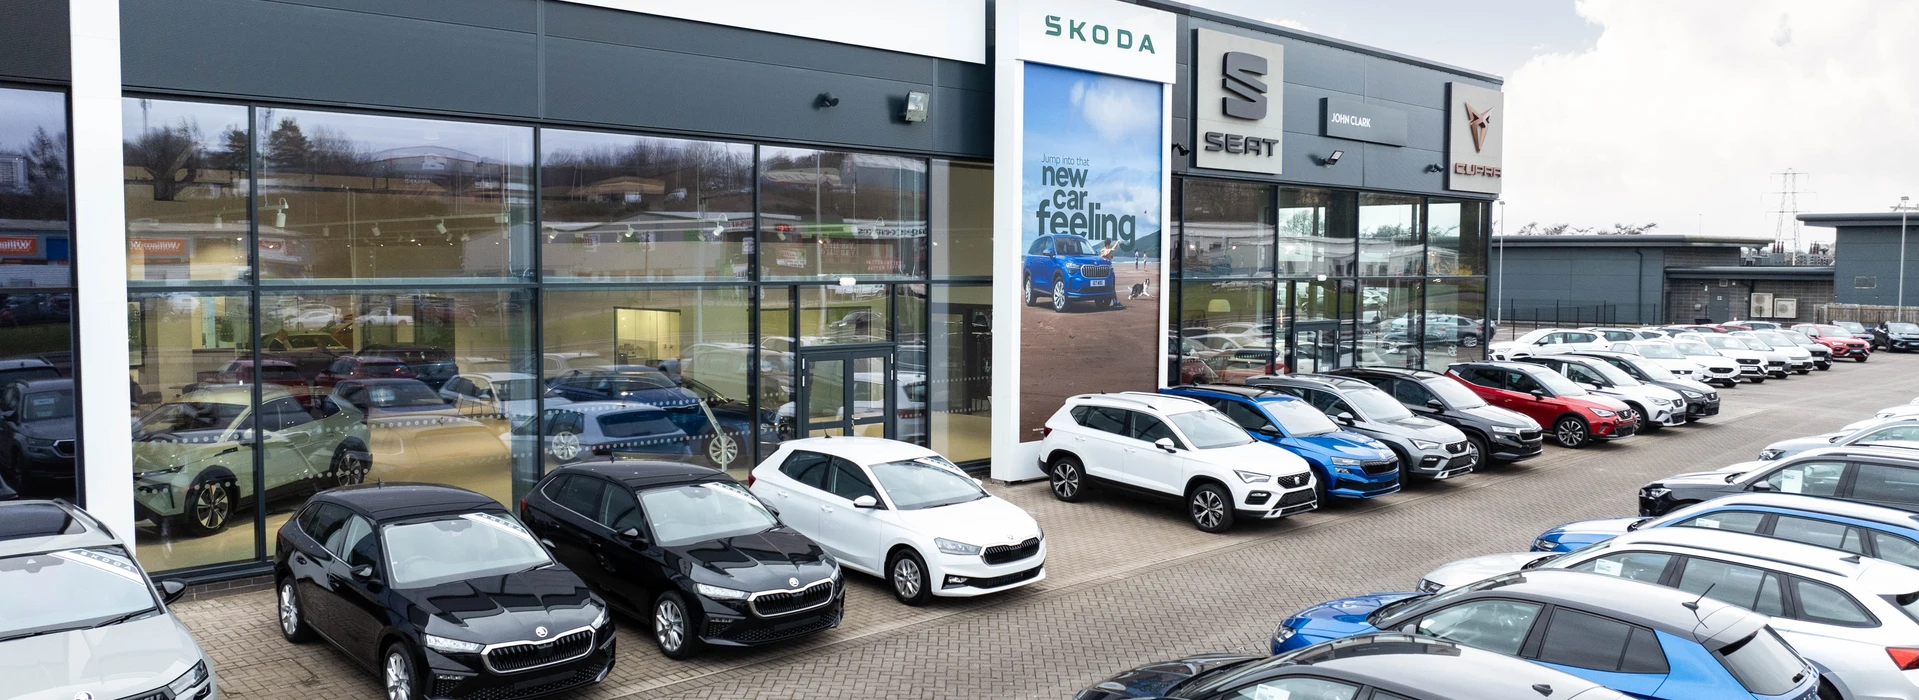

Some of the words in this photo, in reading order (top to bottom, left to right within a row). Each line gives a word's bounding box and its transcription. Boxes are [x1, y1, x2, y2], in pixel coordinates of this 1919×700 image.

[1331, 112, 1350, 124] JOHN
[1350, 115, 1371, 128] CLARK
[1204, 131, 1279, 157] SEAT
[1041, 153, 1061, 166] Jump
[1062, 155, 1075, 165] into
[1076, 156, 1090, 167] that
[1454, 162, 1502, 178] CUPRA
[1042, 165, 1088, 188] new
[1053, 189, 1088, 210] car
[1036, 199, 1136, 252] feeling
[79, 550, 132, 571] SKODA
